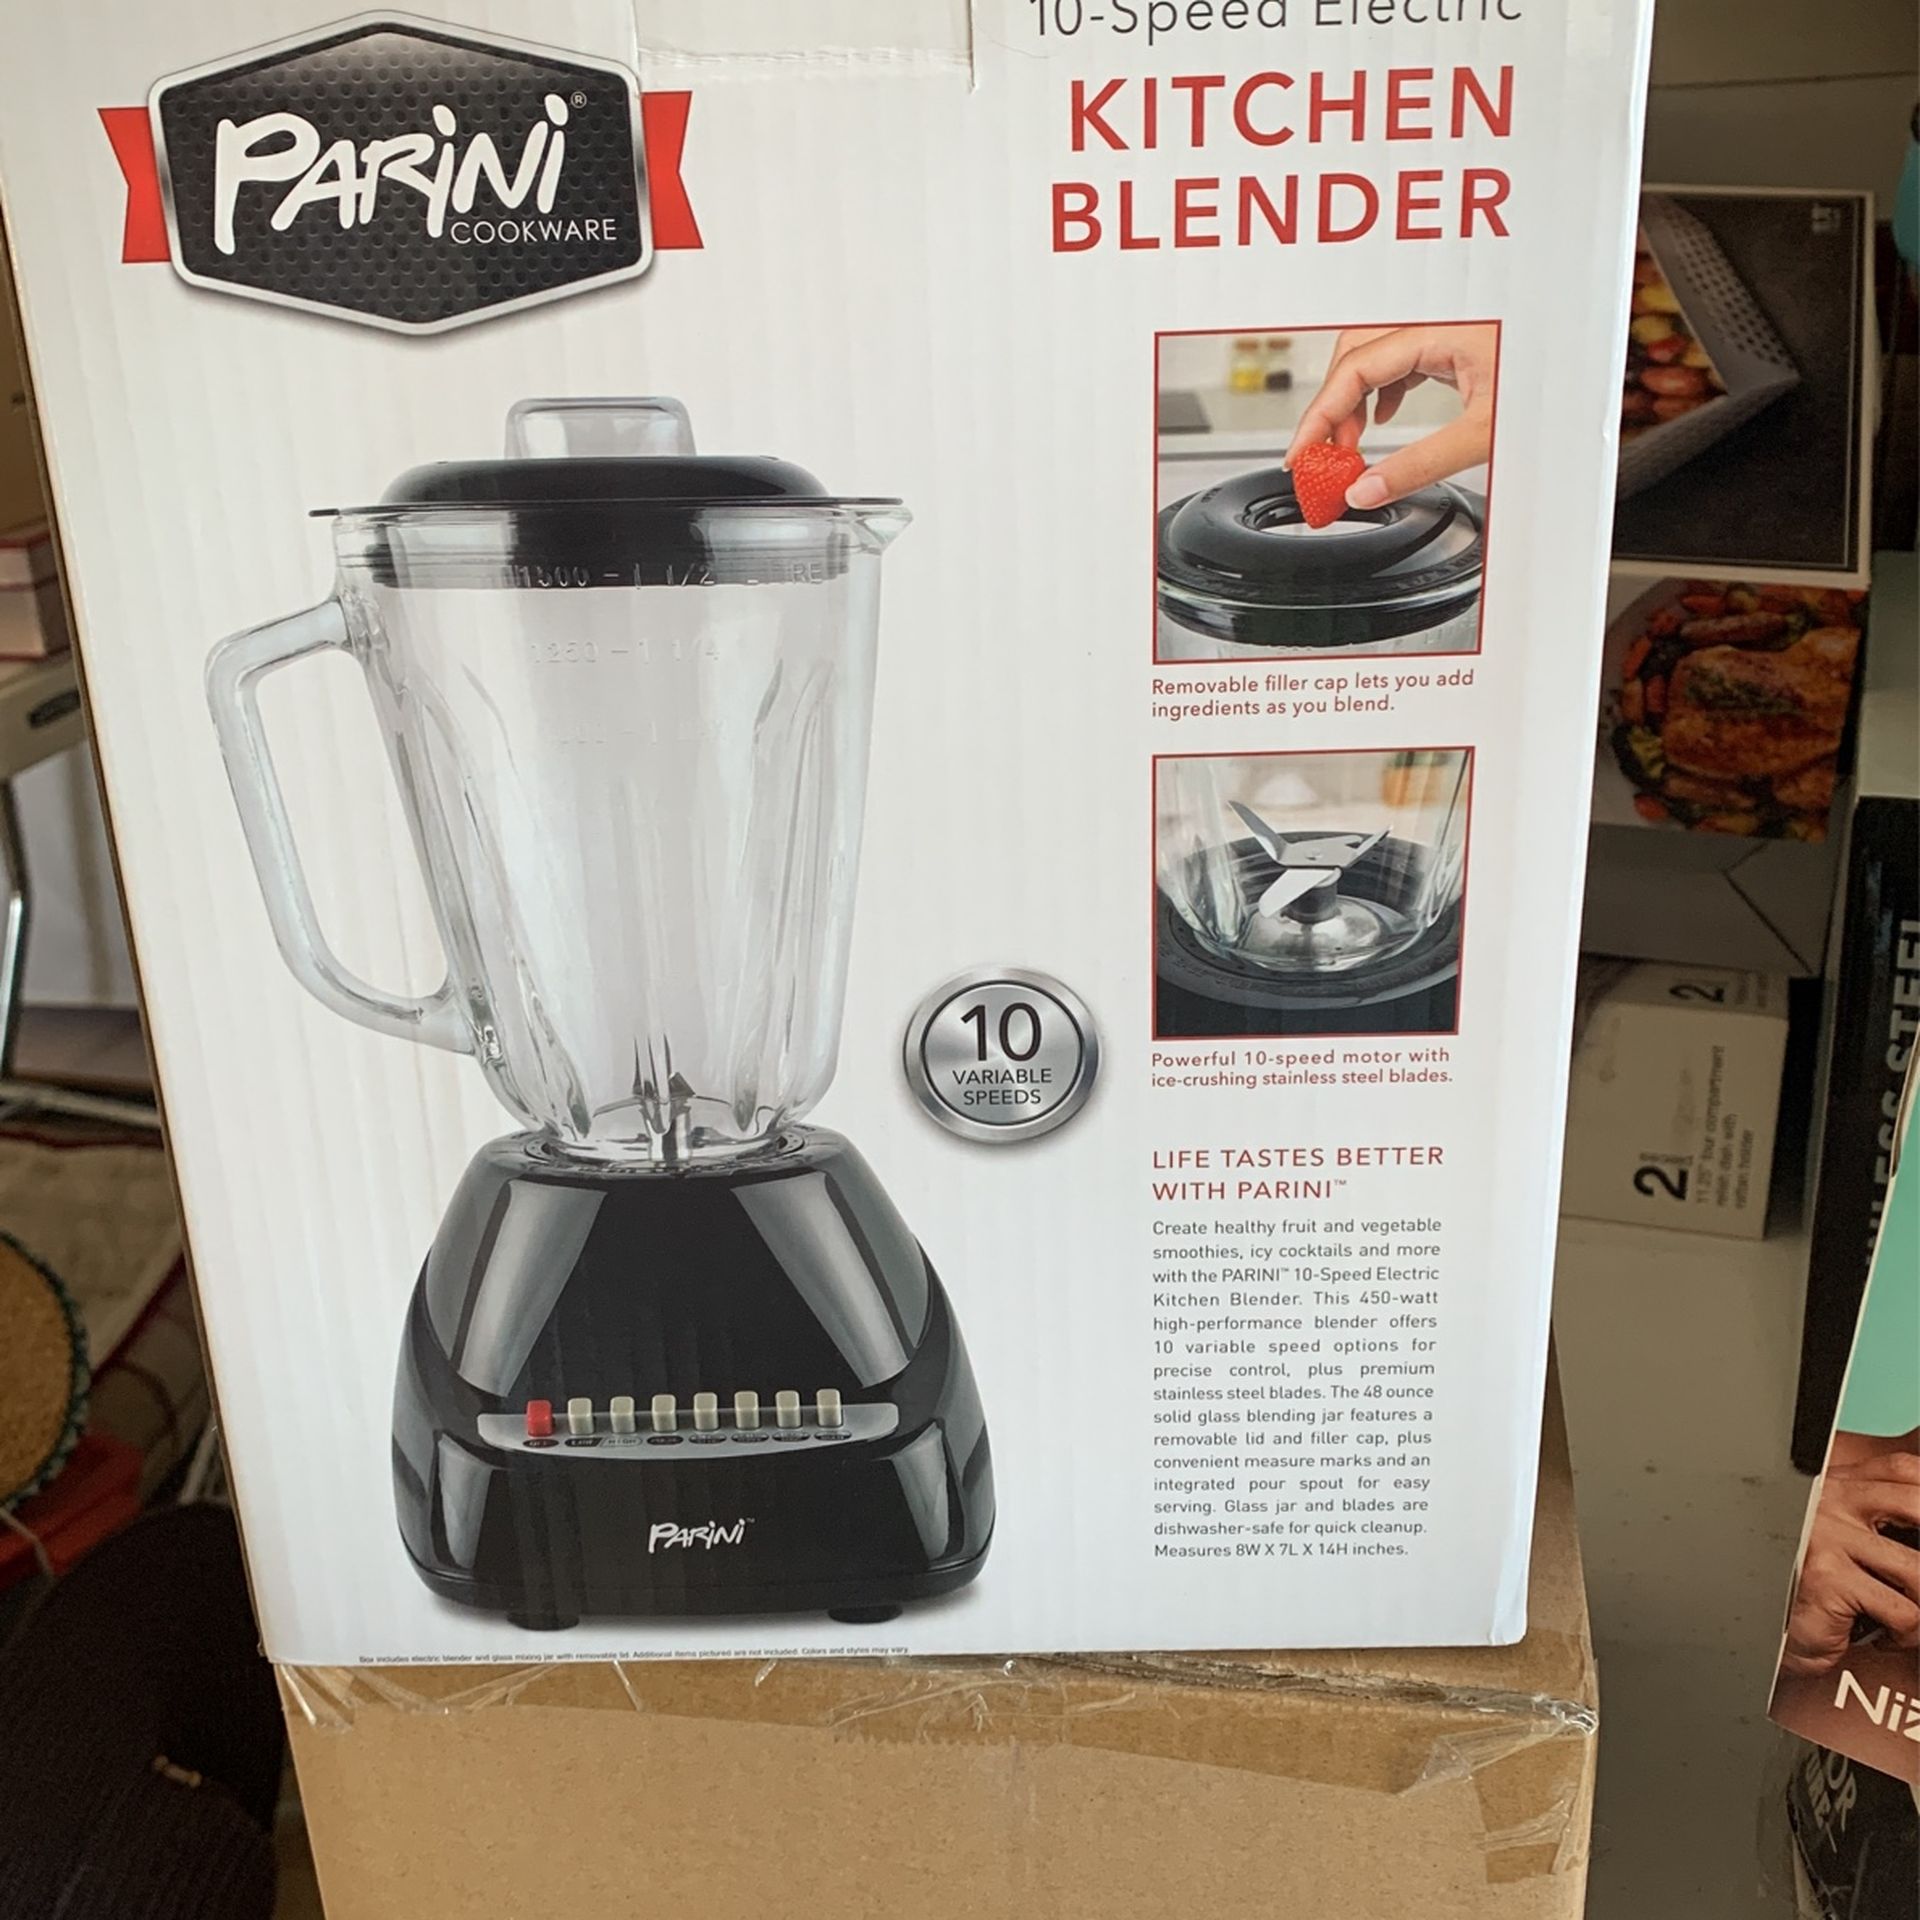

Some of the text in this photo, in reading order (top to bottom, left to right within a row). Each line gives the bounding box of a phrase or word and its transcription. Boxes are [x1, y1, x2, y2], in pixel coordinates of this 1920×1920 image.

[1030, 0, 1286, 46] 10-Speed
[1071, 66, 1514, 152] KITCHEN
[1052, 167, 1512, 252] BLENDER
[451, 218, 617, 245] COOKWARE
[1152, 668, 1474, 696] Removable filler cap lets you add
[1152, 694, 1394, 721] ingredients as you blend.
[960, 1002, 1042, 1062] 10
[1152, 1047, 1449, 1069] Powerful 10-speed motor with
[952, 1068, 1053, 1085] VARIABLE
[1152, 1067, 1453, 1089] ice-crushing stainless steel blades.
[963, 1089, 1041, 1106] SPEEDS
[1154, 1146, 1443, 1169] LIFE TASTES BETTER
[1152, 1182, 1225, 1200] WITH
[1633, 1165, 1689, 1200] 2
[1153, 1218, 1441, 1237] Create healthy fruit and vegetable
[1153, 1243, 1440, 1263] smoothies, icy cocktails and more
[1153, 1268, 1187, 1283] with
[1191, 1268, 1217, 1283] the
[1294, 1267, 1372, 1285] 10-Speed
[1376, 1266, 1439, 1281] Electric
[1154, 1290, 1438, 1307] Kitchen Blender. This 450-watt
[1154, 1314, 1437, 1334] high-performance blender offers
[1155, 1338, 1436, 1356] 10 variable speed options for
[1154, 1361, 1434, 1381] precise control, plus premium
[1154, 1384, 1434, 1400] stainless steel blades. The 48 ounce
[1154, 1408, 1432, 1427] solid glass blending jar features a
[1154, 1431, 1431, 1447] removable lid and filler cap, plus
[1154, 1453, 1430, 1469] convenient measure marks and an
[1154, 1476, 1430, 1495] integrated pour spout for easy
[1154, 1496, 1428, 1516] serving. Glass jar and blades are
[1154, 1519, 1426, 1537] dishwasher-safe for quick cleanup.
[1155, 1542, 1408, 1557] Measures 8W X 7L X 14H inches.
